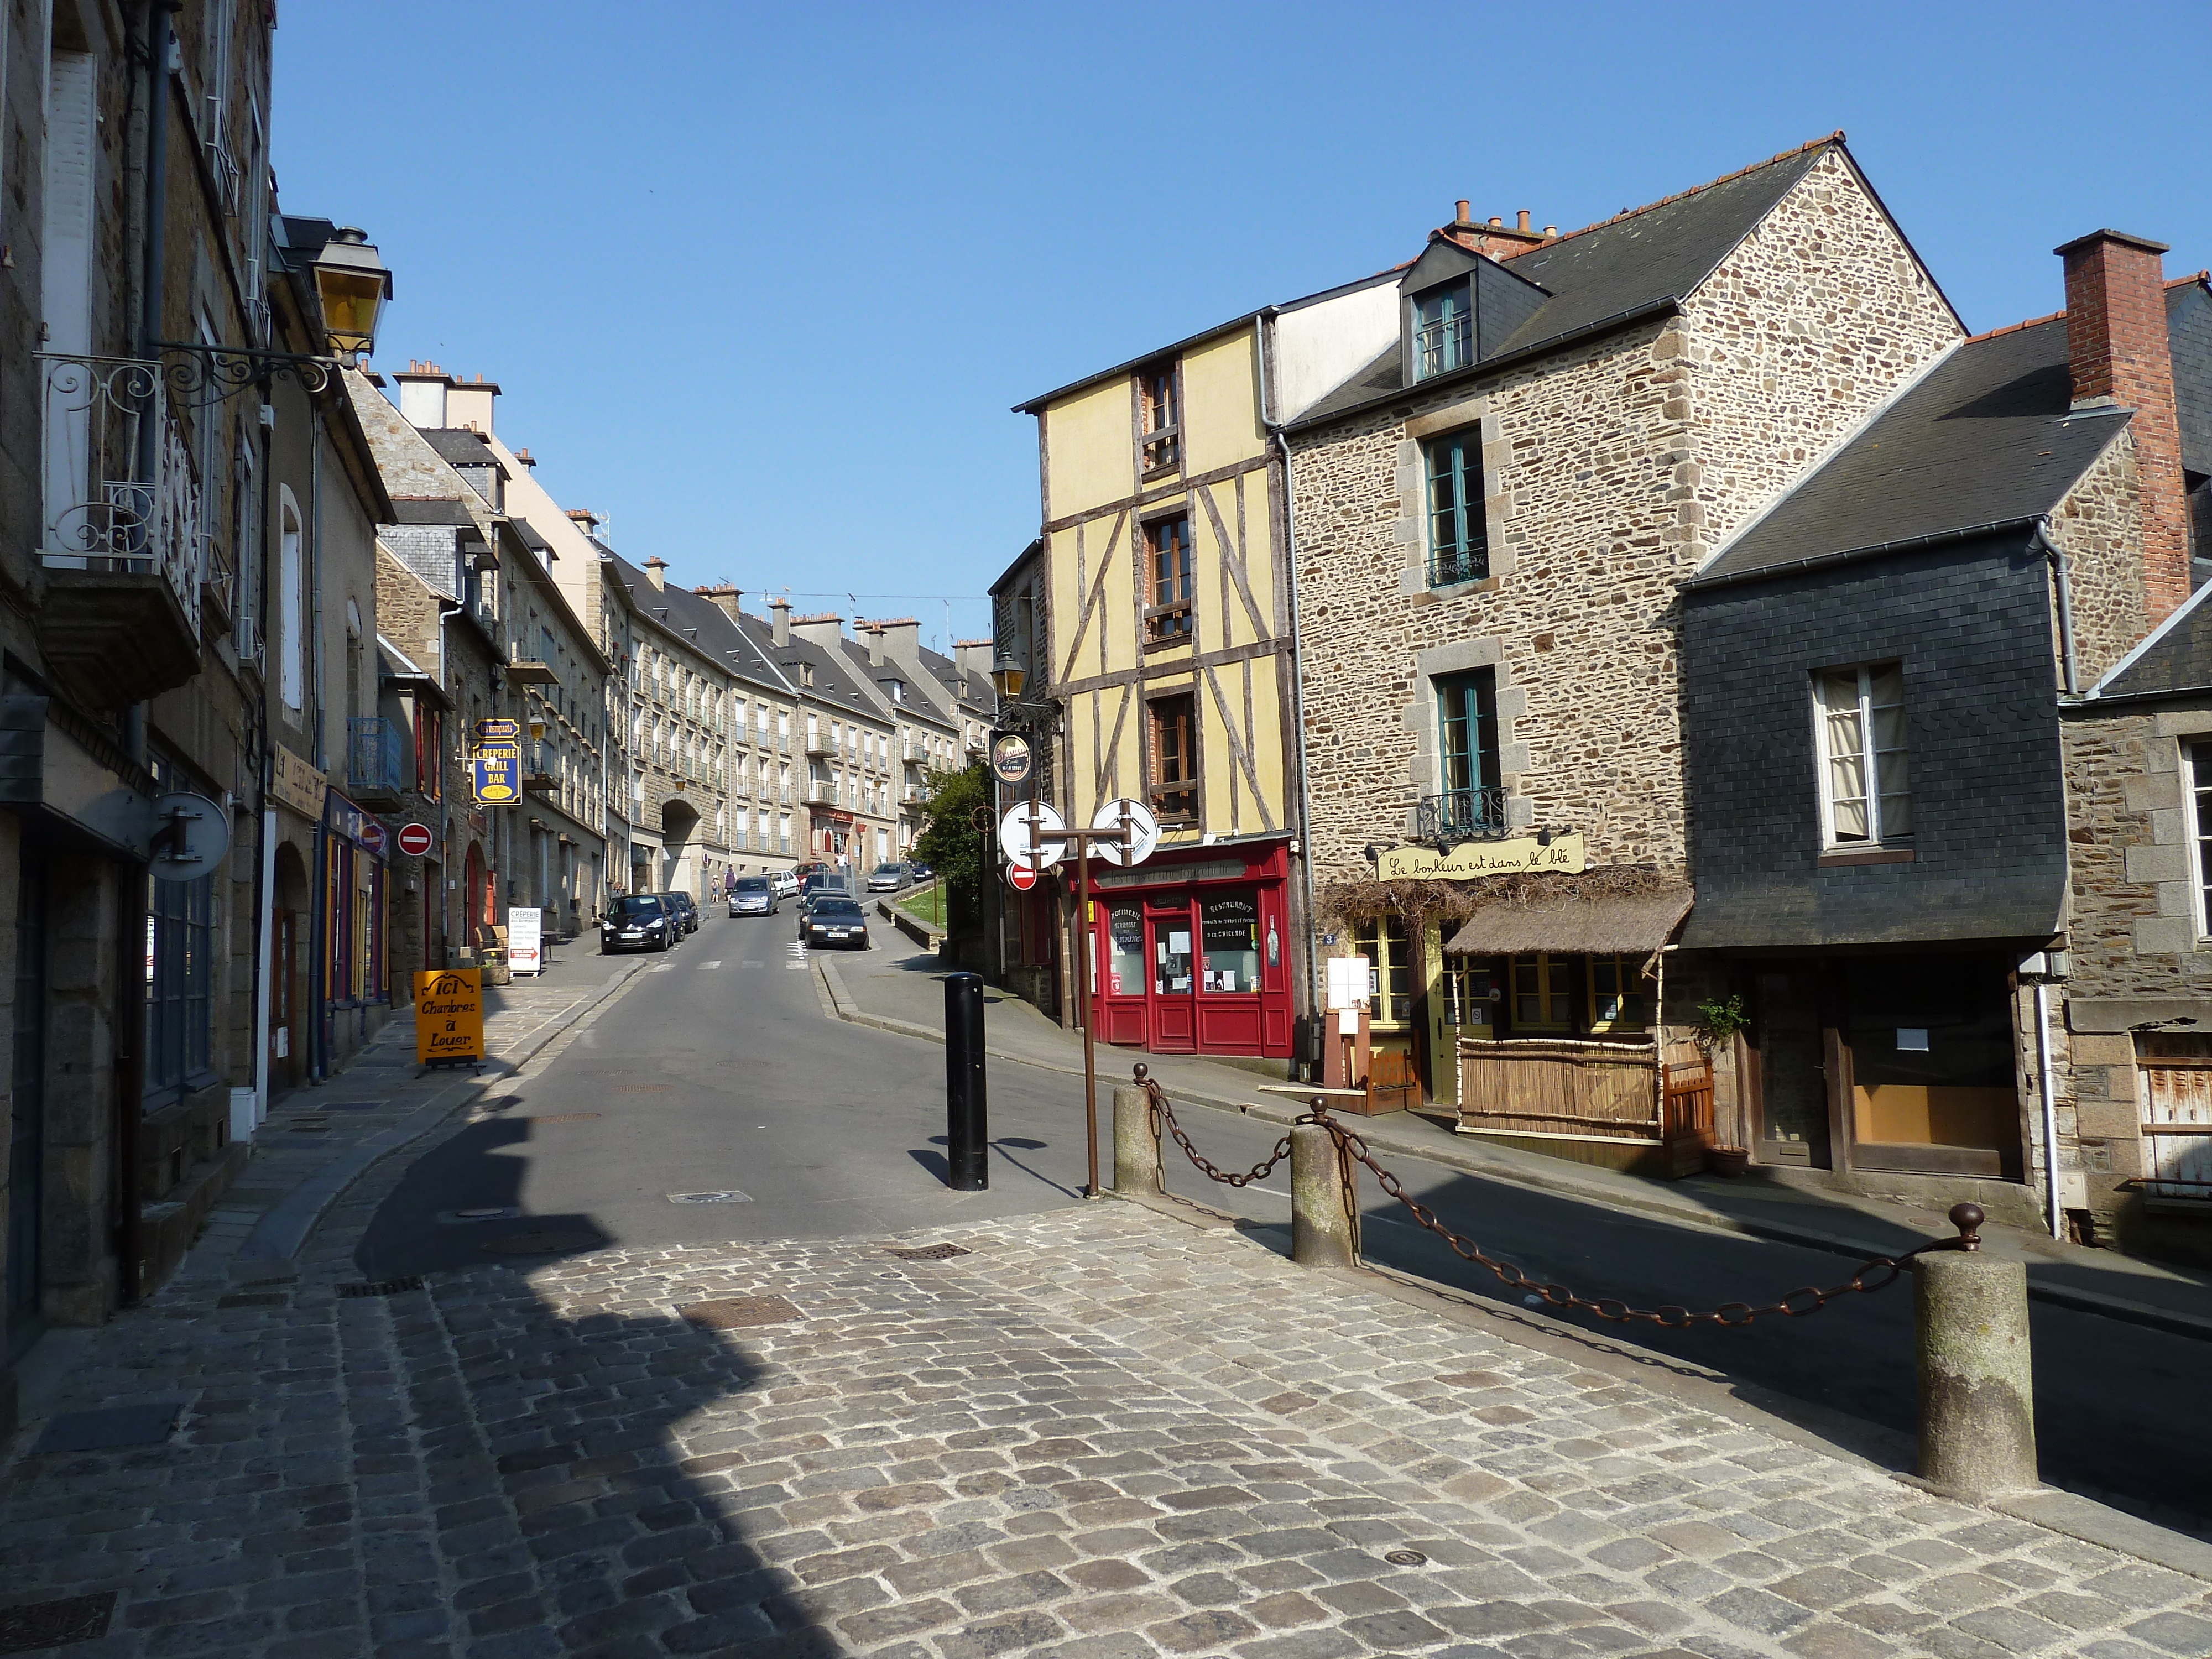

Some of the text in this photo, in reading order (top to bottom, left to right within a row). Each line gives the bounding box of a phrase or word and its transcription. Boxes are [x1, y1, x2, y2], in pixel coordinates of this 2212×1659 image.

[476, 748, 517, 759] CREPERIE
[488, 773, 505, 784] BAR
[1389, 848, 1570, 875] Le bonheur est dans le blé
[1209, 901, 1253, 913] RESTAURANT
[1327, 935, 1332, 944] 3
[422, 999, 475, 1014] Chambres
[431, 1032, 471, 1047] Louer
